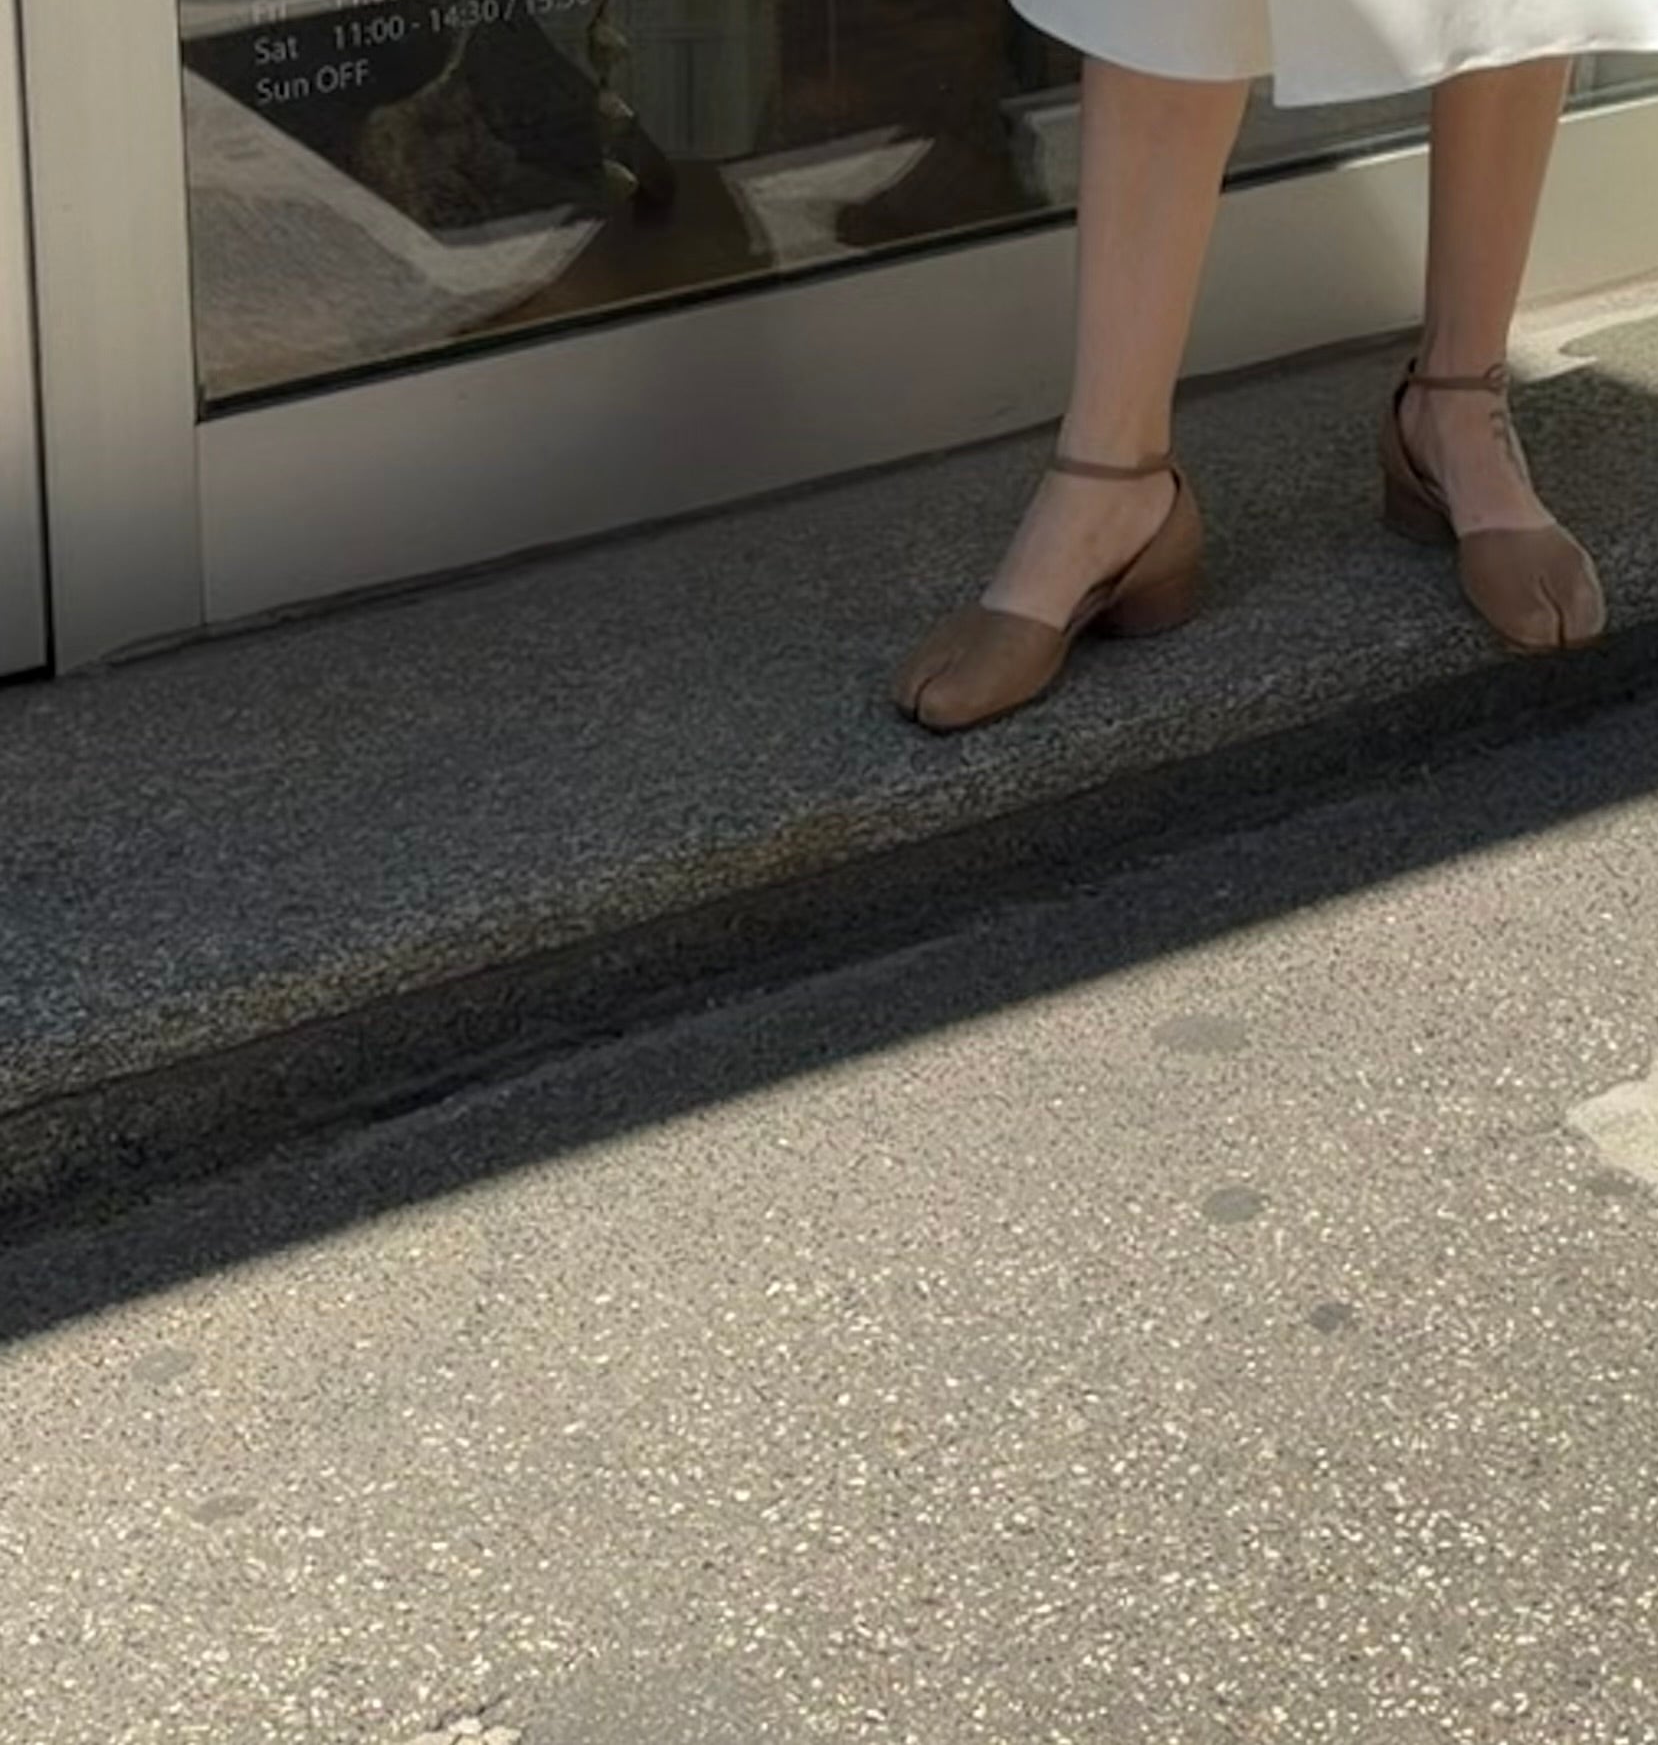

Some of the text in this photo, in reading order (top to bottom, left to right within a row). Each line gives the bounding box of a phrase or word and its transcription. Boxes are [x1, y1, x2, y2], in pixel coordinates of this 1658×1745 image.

[254, 34, 299, 65] Sat
[335, 15, 404, 50] 11:00
[256, 59, 370, 107] Sun OFF
